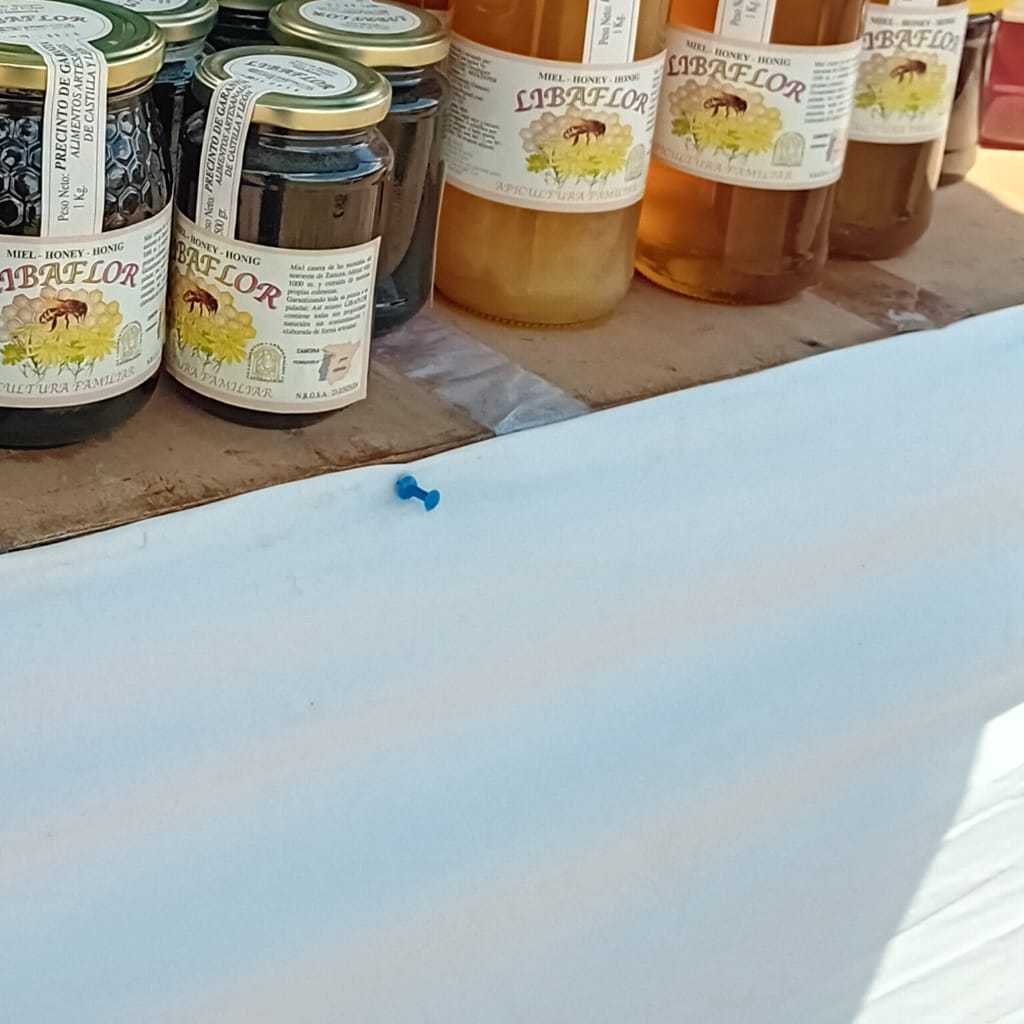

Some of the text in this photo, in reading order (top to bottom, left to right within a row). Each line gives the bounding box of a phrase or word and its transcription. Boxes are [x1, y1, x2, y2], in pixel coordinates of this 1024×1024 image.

[598, 27, 610, 46] Peso
[685, 39, 792, 67] MIEL HONEY HONIG
[59, 78, 72, 100] DE
[538, 71, 566, 83] MIEL
[573, 73, 608, 85] HONEY
[666, 54, 807, 104] LIBAFLOR
[84, 71, 97, 123] CASTILLA
[514, 86, 649, 115] LIBAFLOR
[55, 101, 71, 172] PRECINTO
[70, 92, 84, 158] ALIMENTOS
[83, 125, 95, 143] DE
[229, 121, 243, 164] CASTILLA
[204, 138, 219, 193] PRECINTO
[215, 138, 229, 187] ALIMENTOS
[57, 204, 70, 222] Peso
[6, 241, 125, 259] MIEL HONEY HONIG
[189, 234, 262, 267] HONEY HONIG
[176, 240, 282, 310] BAFLOR
[201, 372, 274, 399] FAMILIAR
